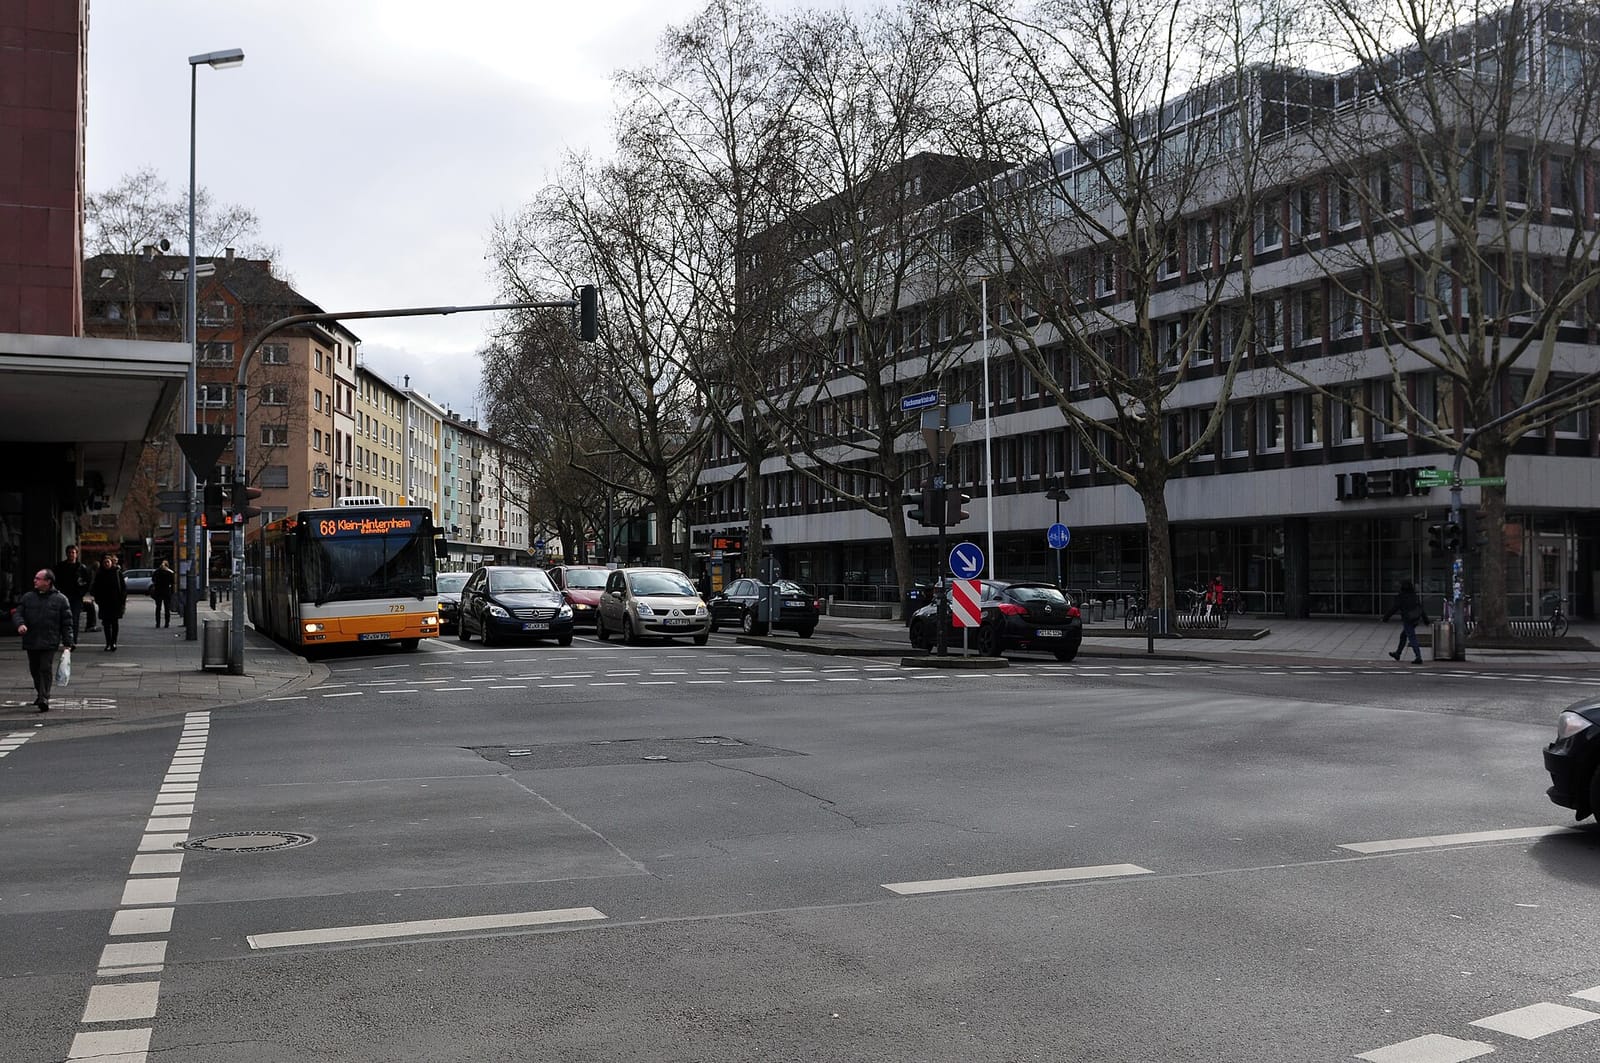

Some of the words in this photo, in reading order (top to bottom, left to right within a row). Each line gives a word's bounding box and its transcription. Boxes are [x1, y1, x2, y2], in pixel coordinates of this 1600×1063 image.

[320, 520, 336, 535] 68
[338, 518, 411, 530] Klein-Winternheim
[360, 527, 388, 535] Bahnhof
[389, 605, 405, 613] 729
